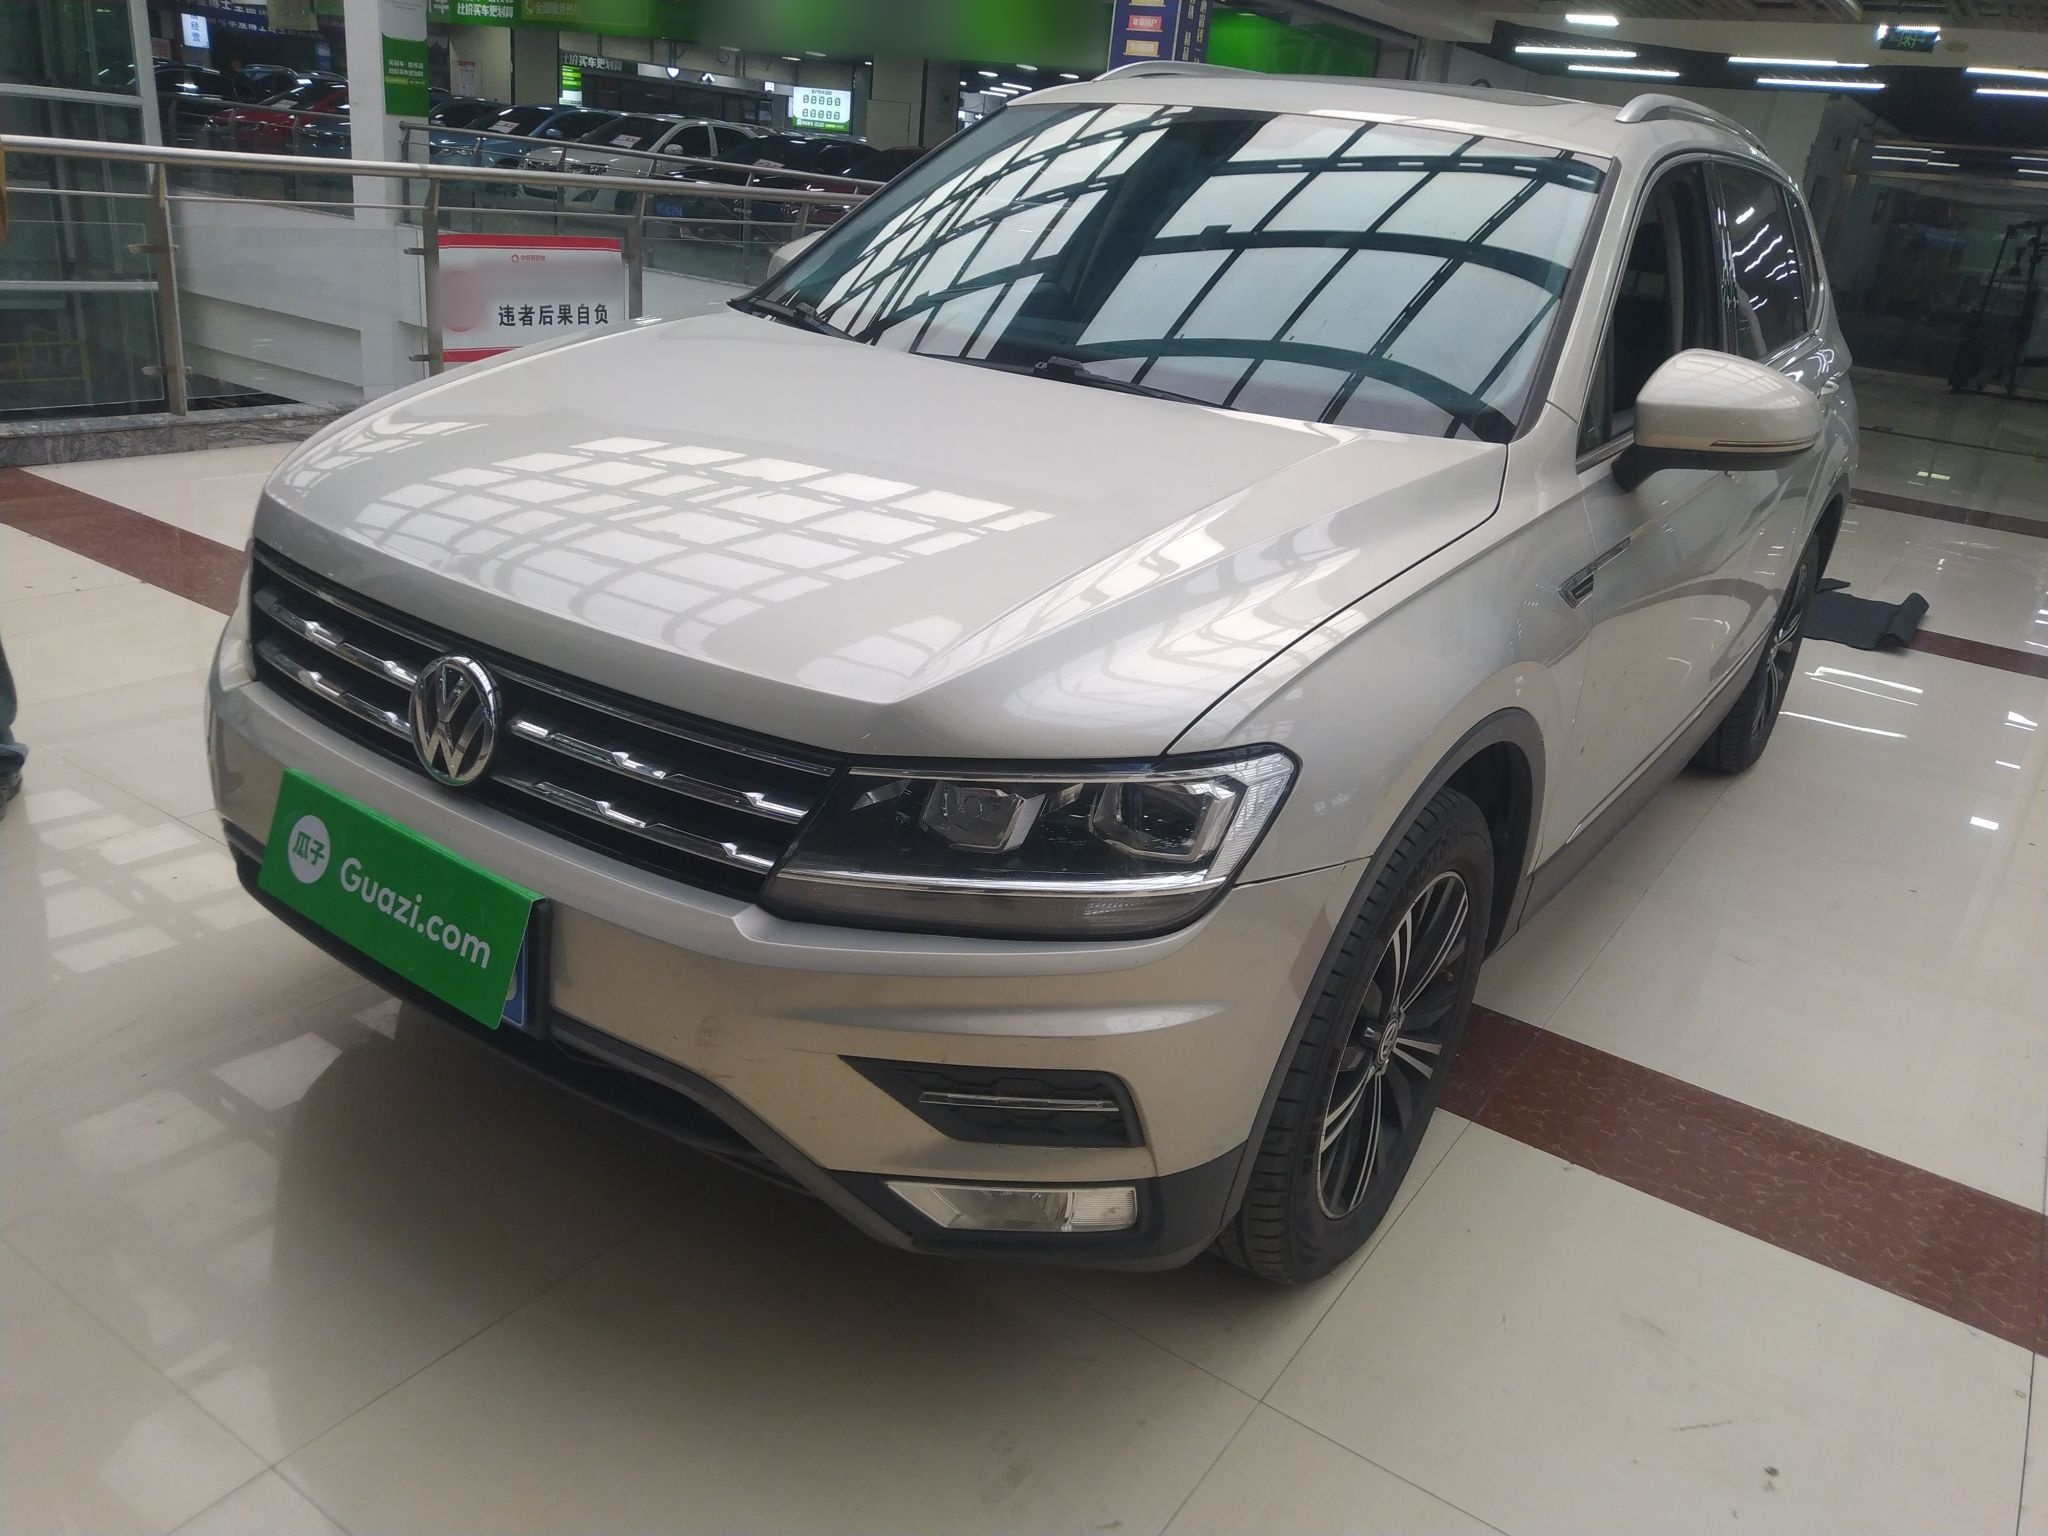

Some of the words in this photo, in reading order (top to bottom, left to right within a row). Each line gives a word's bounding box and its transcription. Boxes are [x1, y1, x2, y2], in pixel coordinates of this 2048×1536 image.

[499, 303, 609, 327] 违者后果自负
[292, 830, 326, 866] 瓜子
[340, 857, 491, 969] Guazi.com
